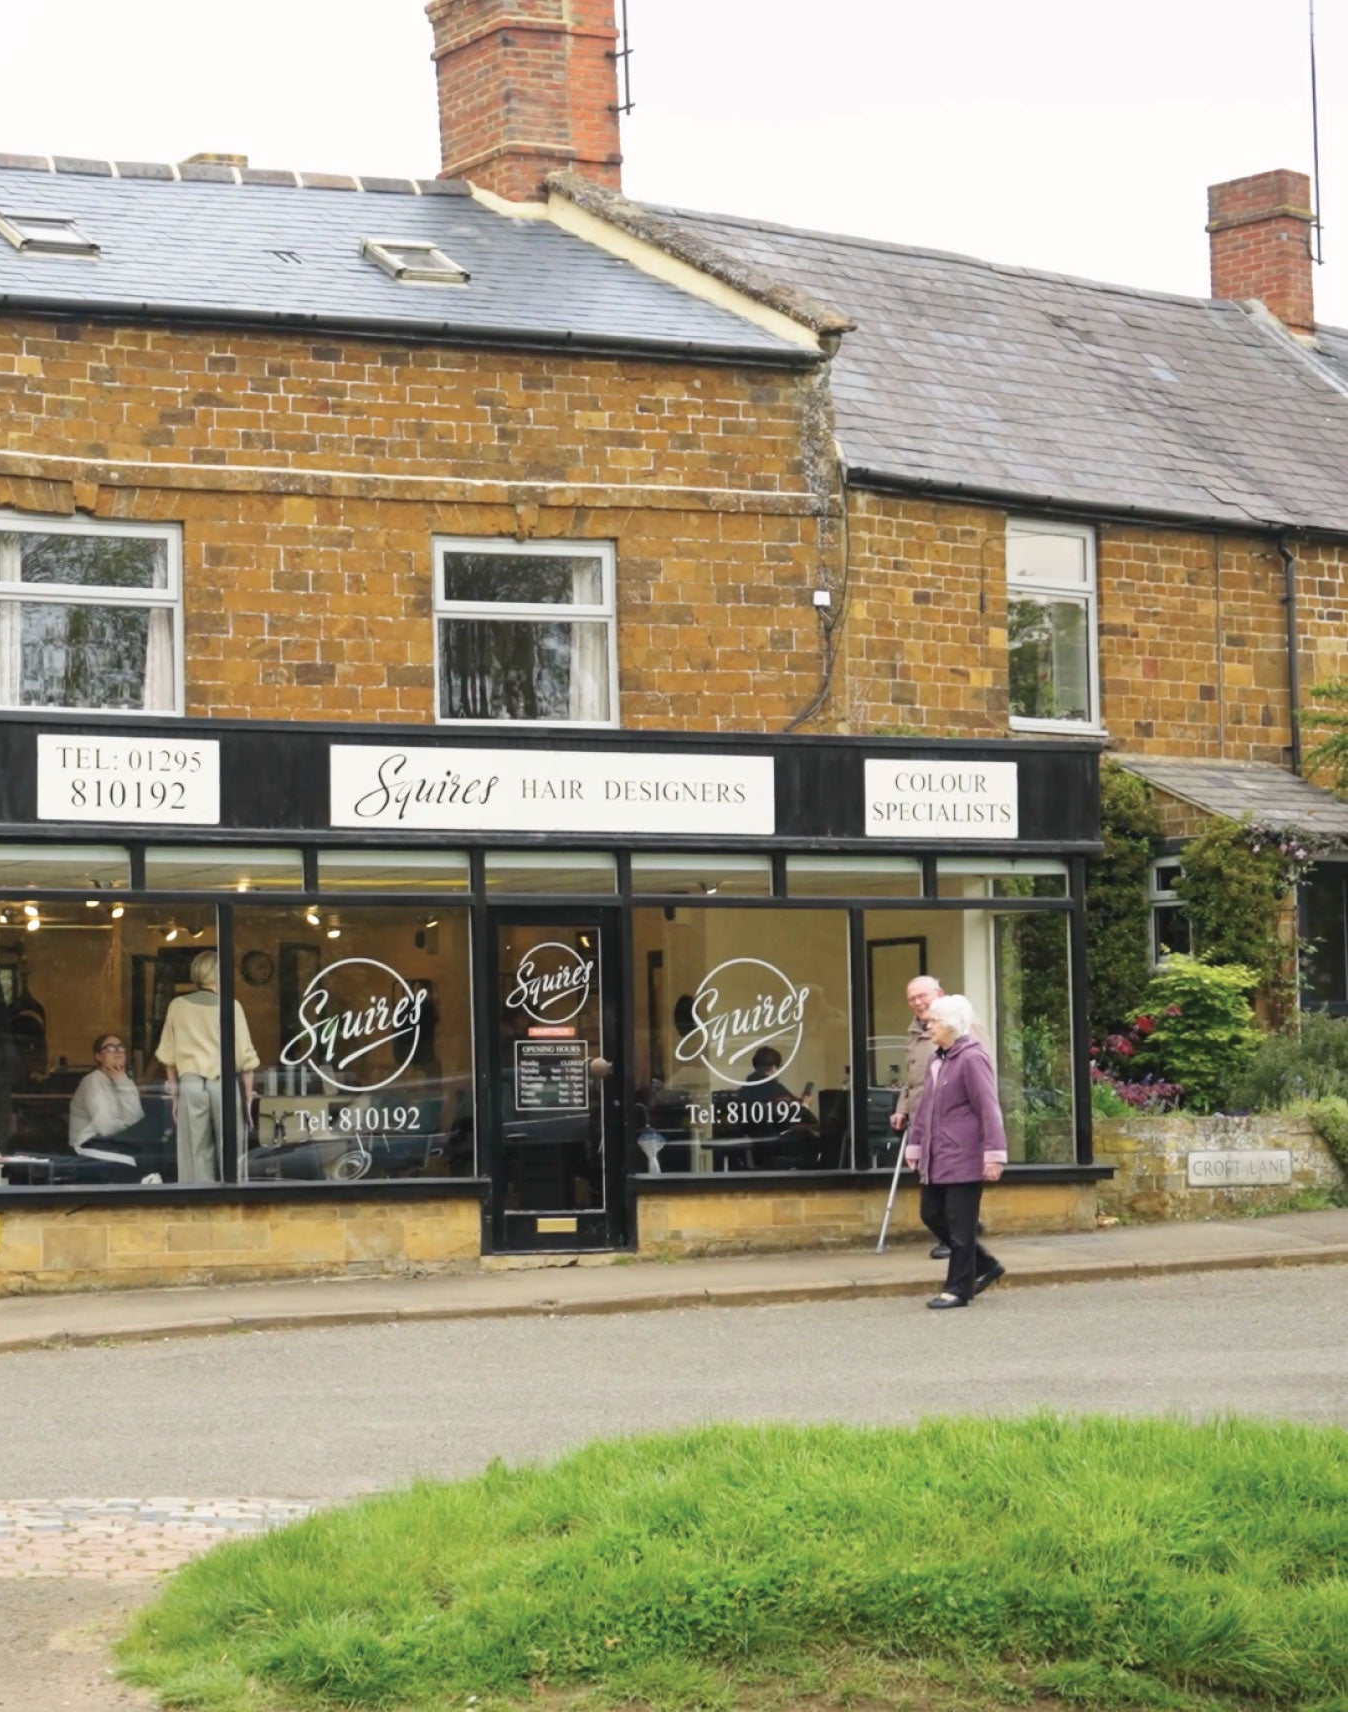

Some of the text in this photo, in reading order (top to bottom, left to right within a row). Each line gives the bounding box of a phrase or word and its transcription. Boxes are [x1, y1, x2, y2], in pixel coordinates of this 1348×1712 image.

[56, 746, 201, 773] TEL: 01295
[71, 778, 186, 810] 810192
[354, 754, 746, 820] Squires HAIR DESIGNERS
[895, 772, 988, 794] COLOUR
[872, 802, 1011, 823] SPECIALISTS
[505, 960, 594, 1008] Squires
[280, 988, 427, 1066] Squires
[675, 987, 810, 1061] Squires
[295, 1106, 421, 1133] Tel: 810192
[685, 1101, 802, 1124] Tel: 810192
[1193, 1158, 1286, 1177] CROFT LANE
